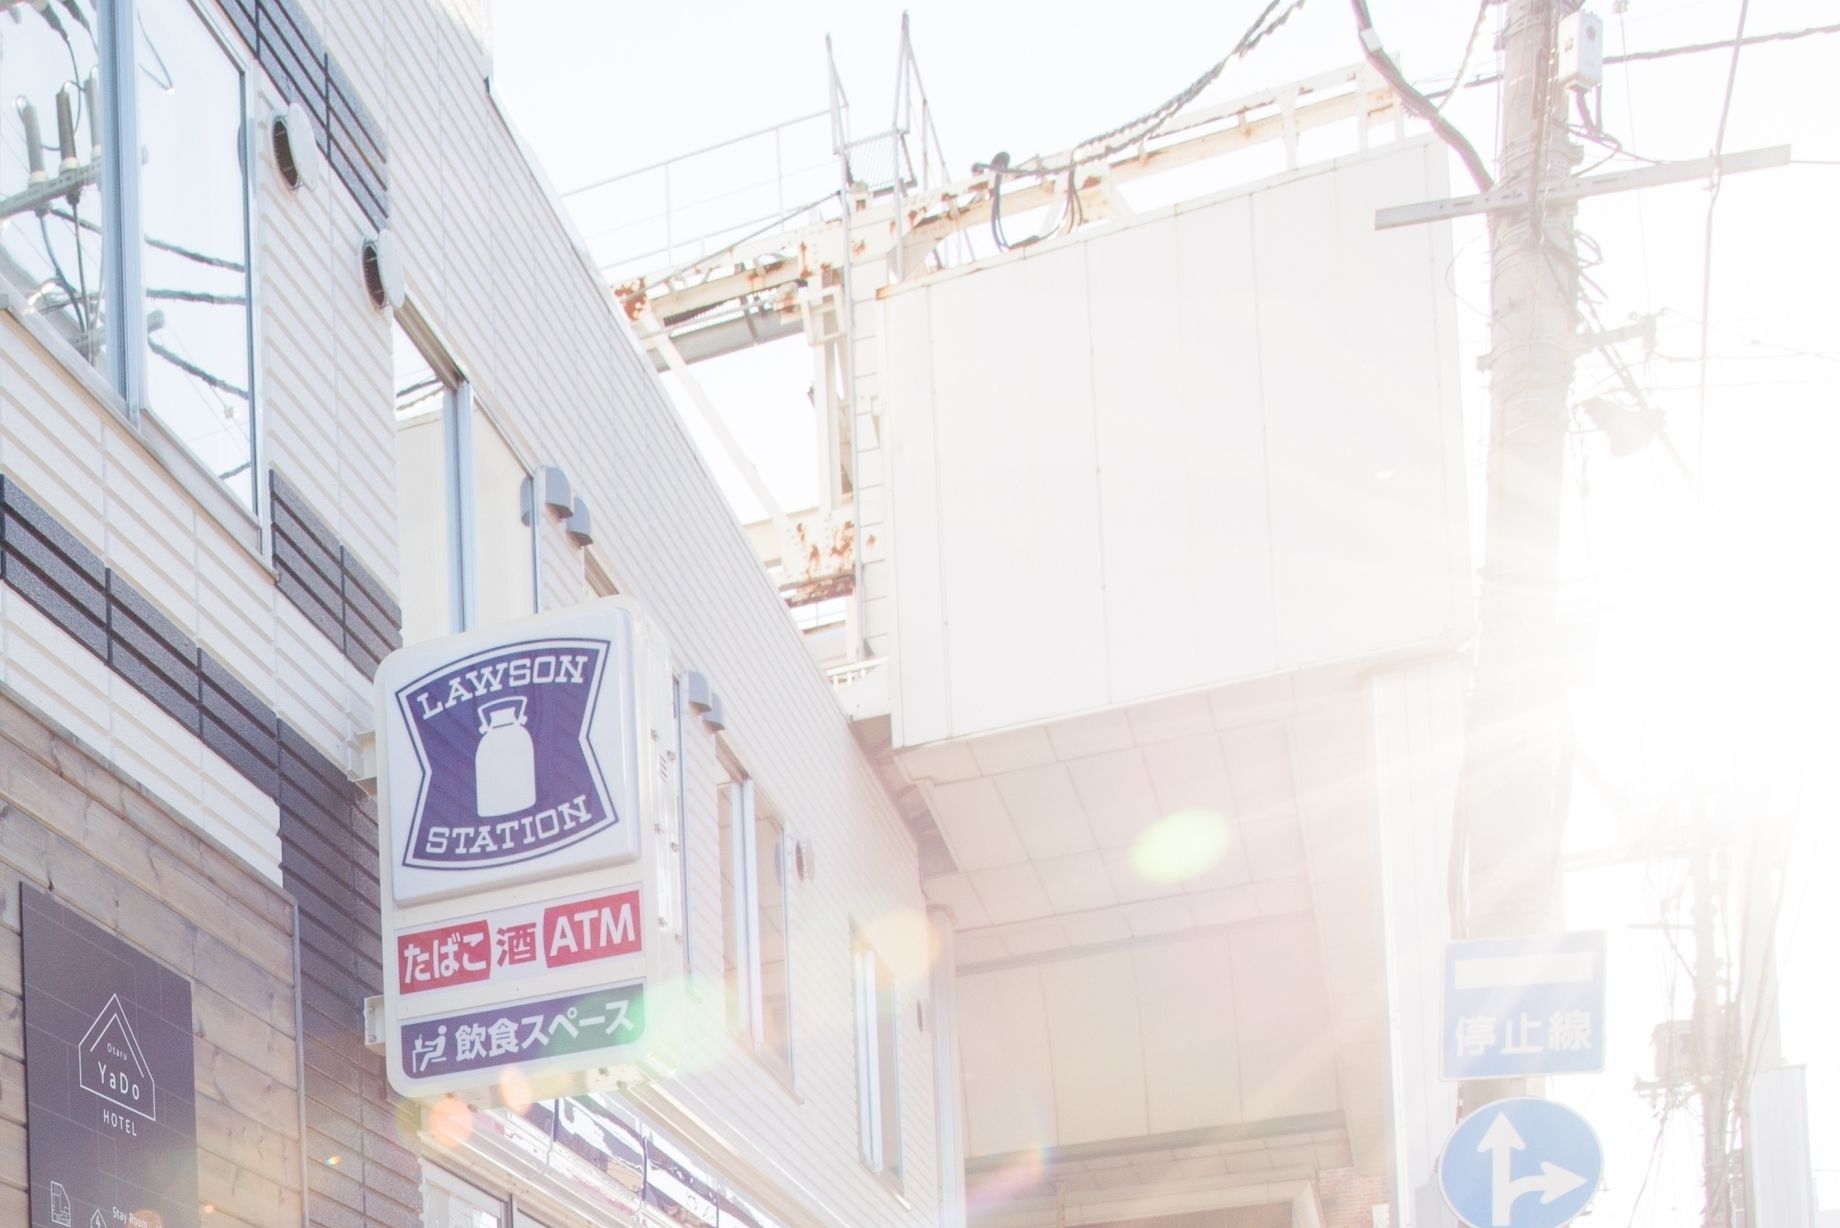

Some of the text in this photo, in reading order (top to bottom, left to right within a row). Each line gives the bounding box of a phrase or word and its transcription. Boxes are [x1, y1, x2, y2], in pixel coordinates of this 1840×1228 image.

[416, 654, 589, 721] LAWSON
[424, 794, 592, 856] STATION
[403, 902, 636, 985] たばこ 酒 ATM
[106, 1042, 129, 1063] Otaru
[455, 1000, 635, 1062] 飲食スペース
[1454, 1009, 1592, 1058] 停止線
[97, 1060, 141, 1103] YaDo
[102, 1109, 138, 1137] HOTEL
[112, 1206, 128, 1225] Stay
